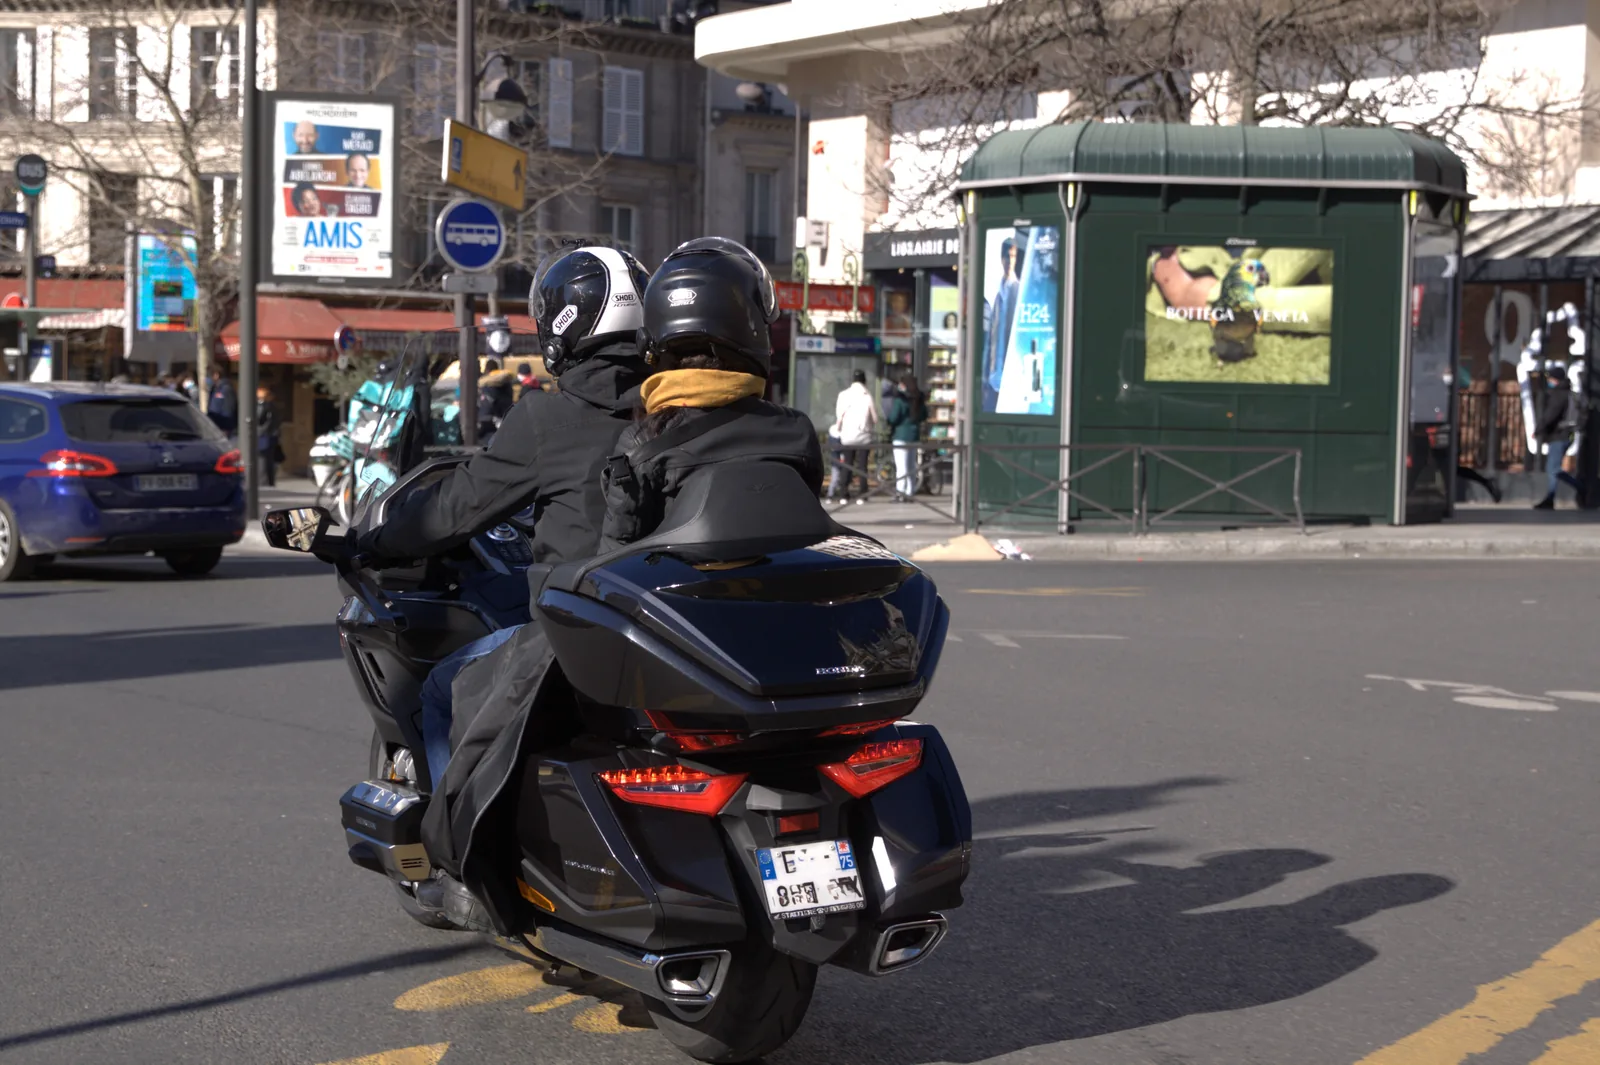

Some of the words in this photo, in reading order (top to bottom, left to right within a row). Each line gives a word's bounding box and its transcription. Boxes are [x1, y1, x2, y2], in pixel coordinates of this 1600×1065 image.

[303, 220, 363, 249] AMIS
[890, 239, 944, 257] LIBRAIRIE
[615, 294, 634, 302] SHOEI
[554, 308, 575, 332] SHOEI
[1019, 303, 1051, 324] H24
[1165, 306, 1235, 322] BOTTEGA
[1252, 308, 1309, 324] VENETA
[839, 854, 854, 869] 75
[765, 868, 771, 878] F
